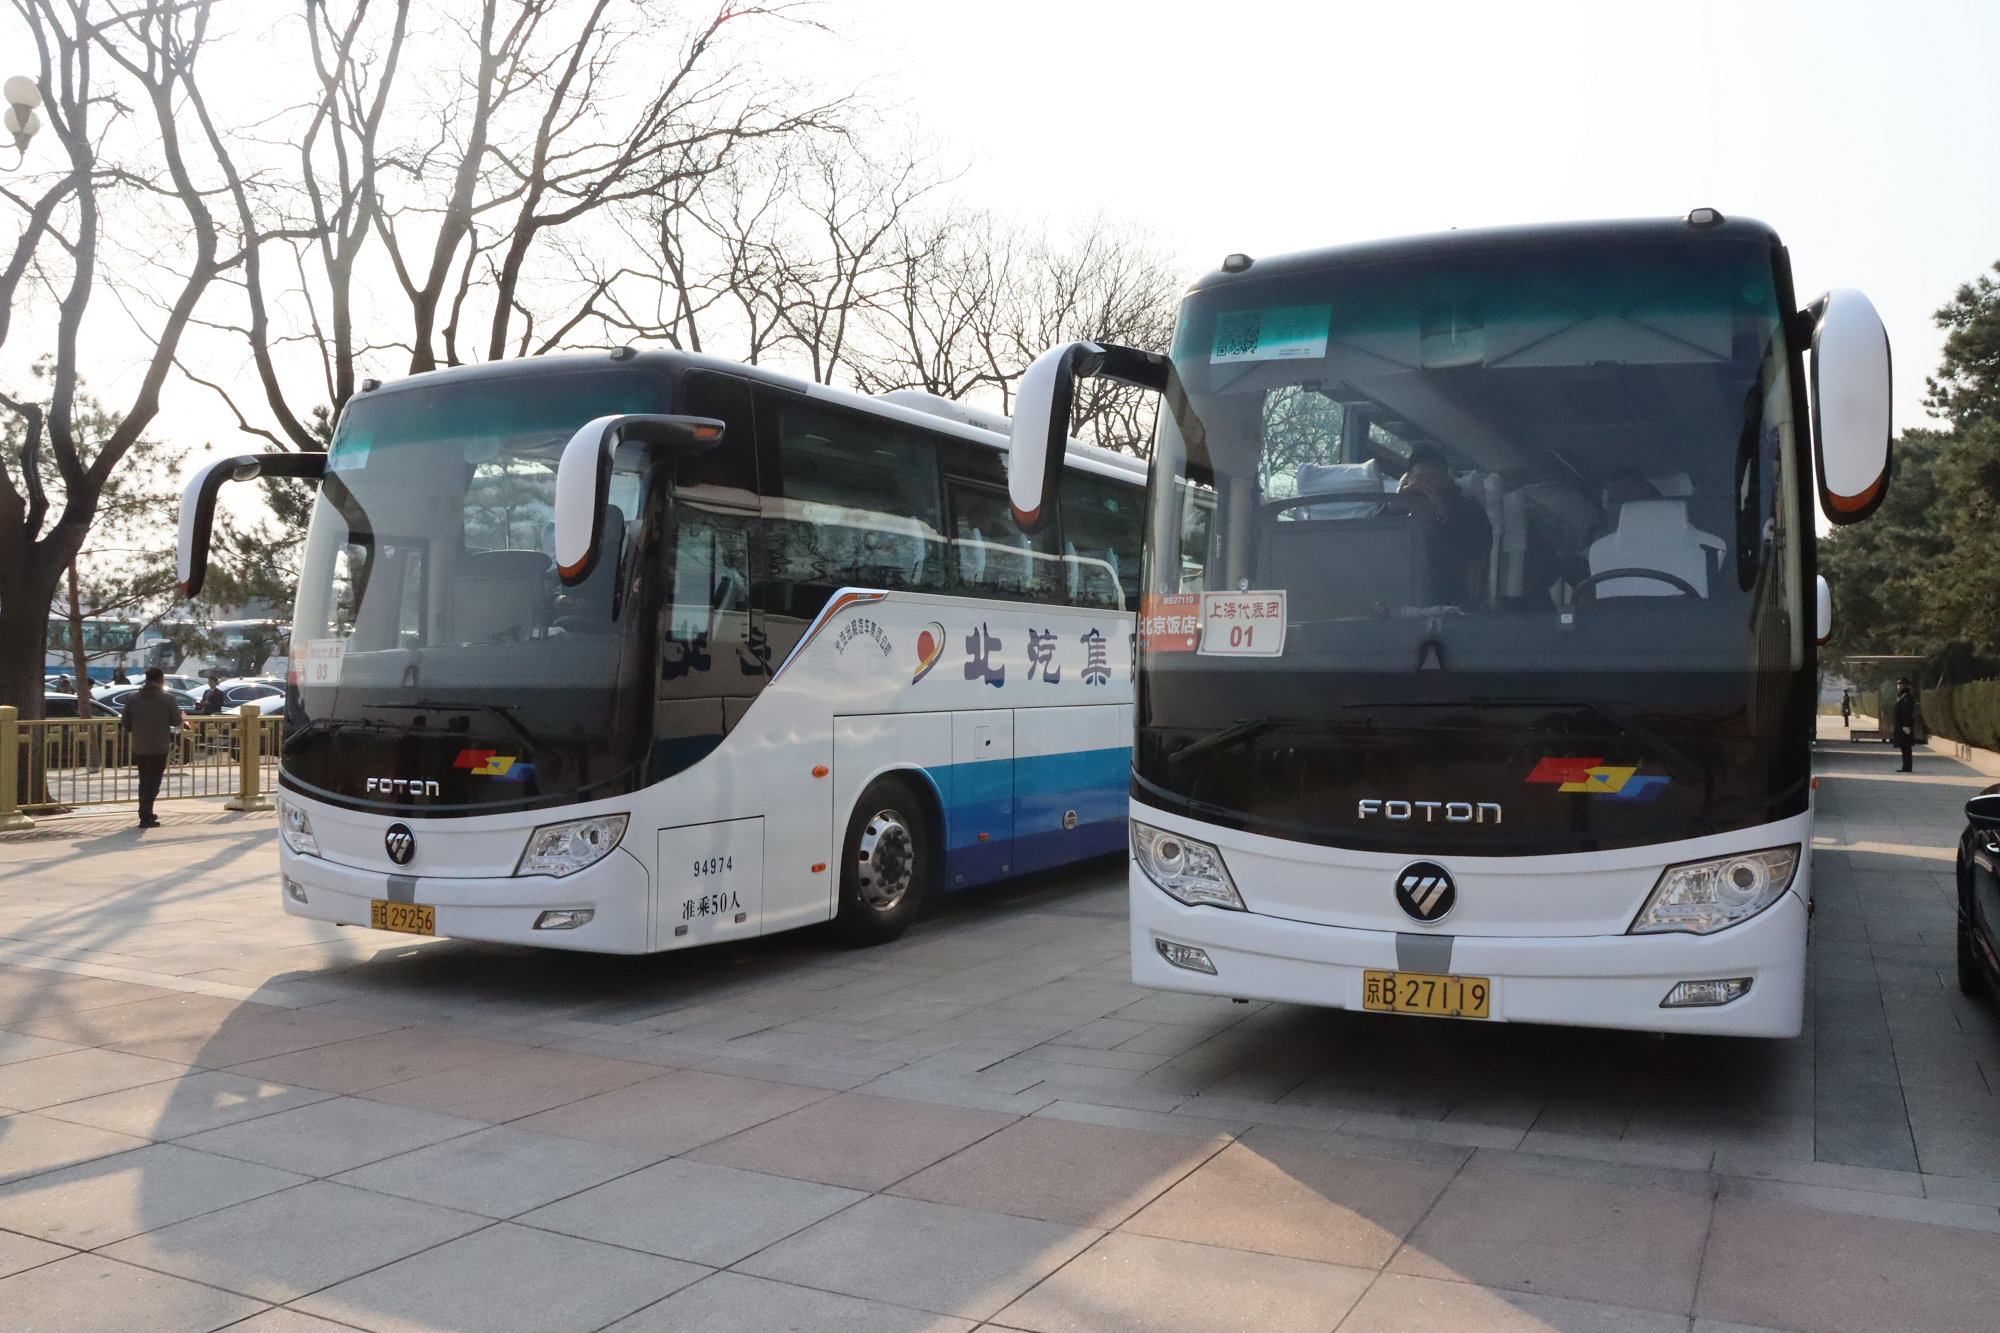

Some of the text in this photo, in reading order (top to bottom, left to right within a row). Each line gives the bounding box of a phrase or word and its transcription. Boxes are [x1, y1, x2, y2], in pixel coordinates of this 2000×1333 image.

[1209, 601, 1280, 620] 上海代表团
[1140, 614, 1197, 636] 北京饭店
[1229, 625, 1254, 648] 01
[963, 621, 1137, 689] 北汽集
[316, 663, 328, 681] 03
[366, 777, 440, 797] FOTON
[1358, 799, 1502, 824] FOTON
[693, 855, 733, 877] 94974
[682, 890, 741, 921] 准乘50人
